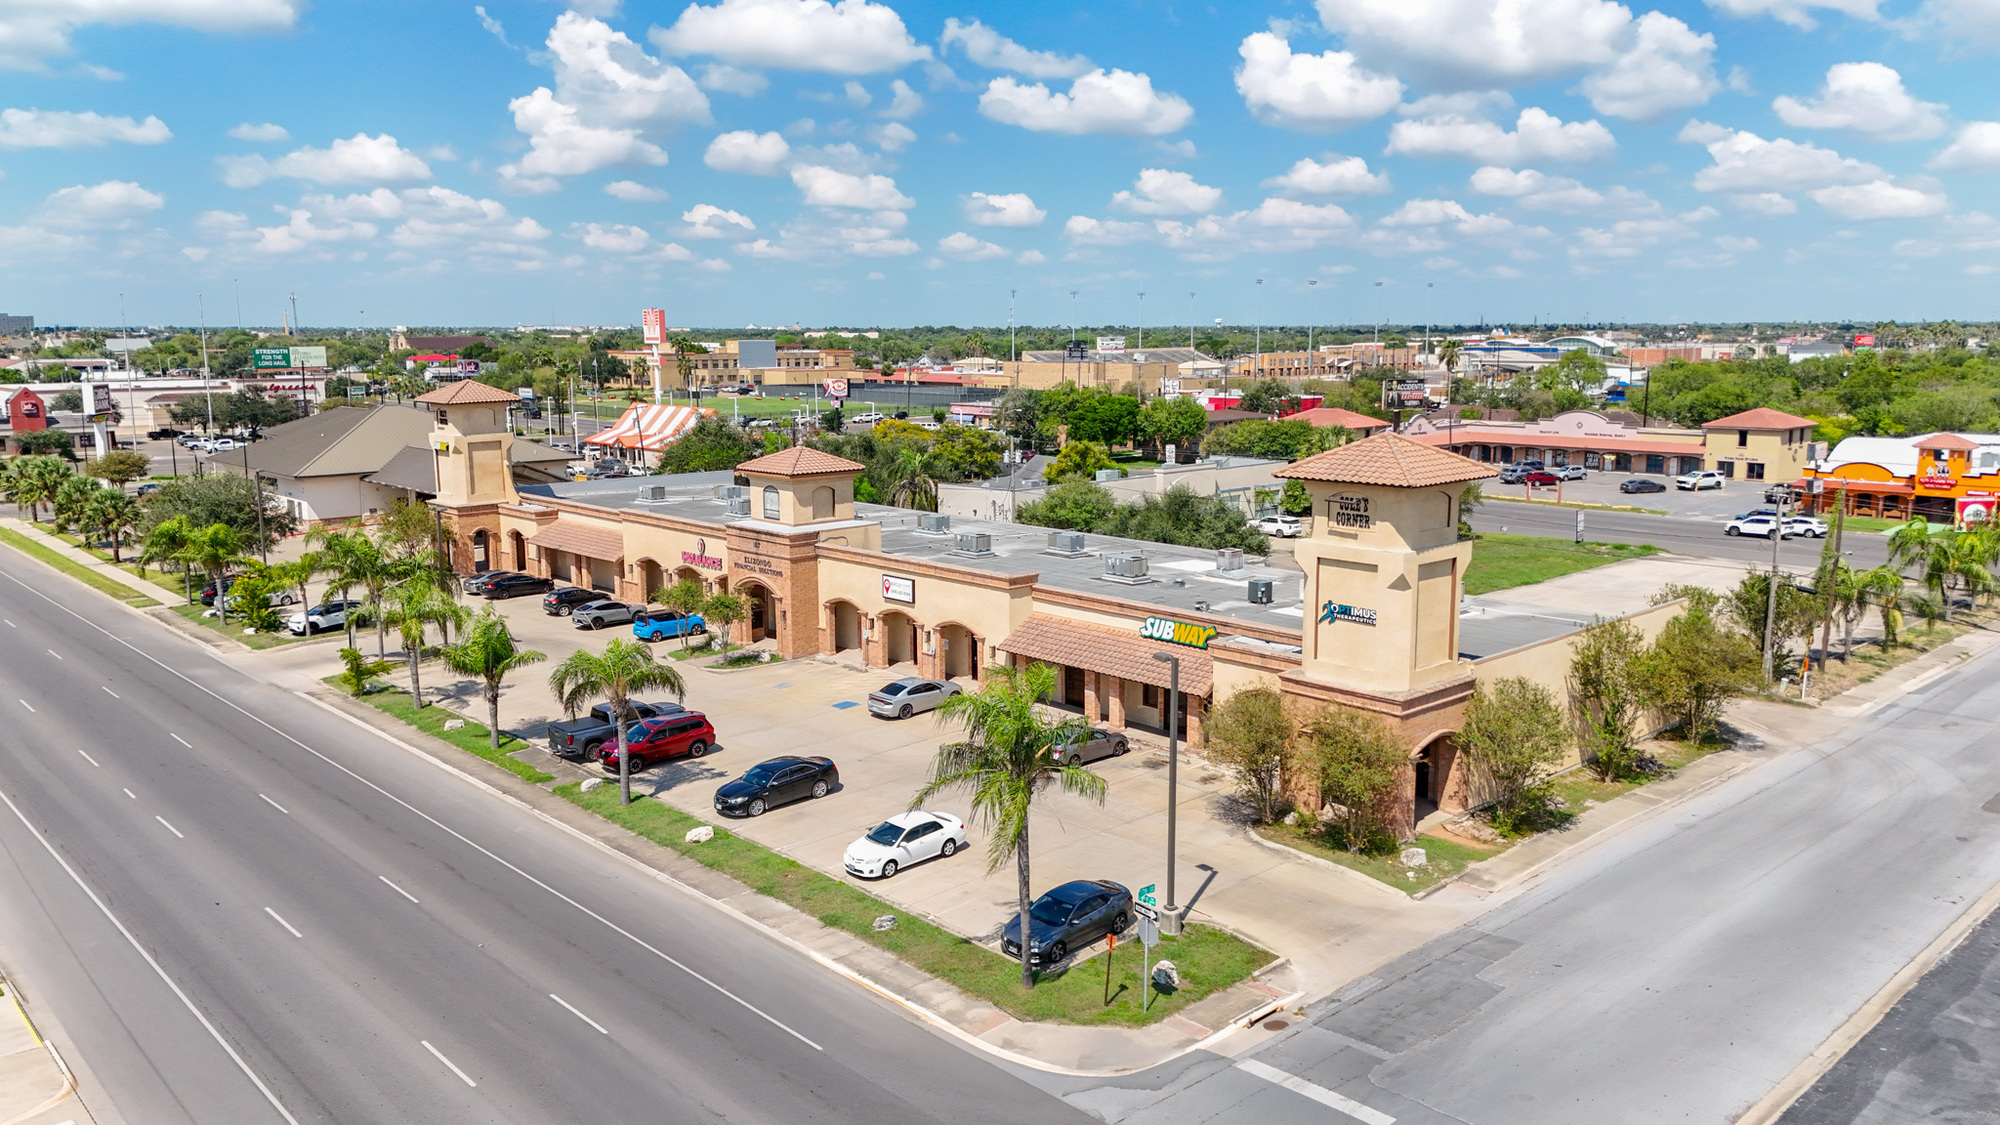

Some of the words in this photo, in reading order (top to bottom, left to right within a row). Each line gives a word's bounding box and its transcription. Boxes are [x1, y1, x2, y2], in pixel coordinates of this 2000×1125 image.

[1340, 496, 1369, 512] COLE'S
[1336, 512, 1370, 528] CORNER
[682, 552, 722, 570] INSURANCE
[744, 556, 772, 568] ELIZONDO
[734, 562, 756, 572] FINANCIAL
[758, 566, 783, 577] SOLUTIONS
[1330, 604, 1376, 619] OPTIMUS
[1334, 613, 1376, 624] THERAPEUTICS
[1140, 618, 1216, 646] SUBWAY
